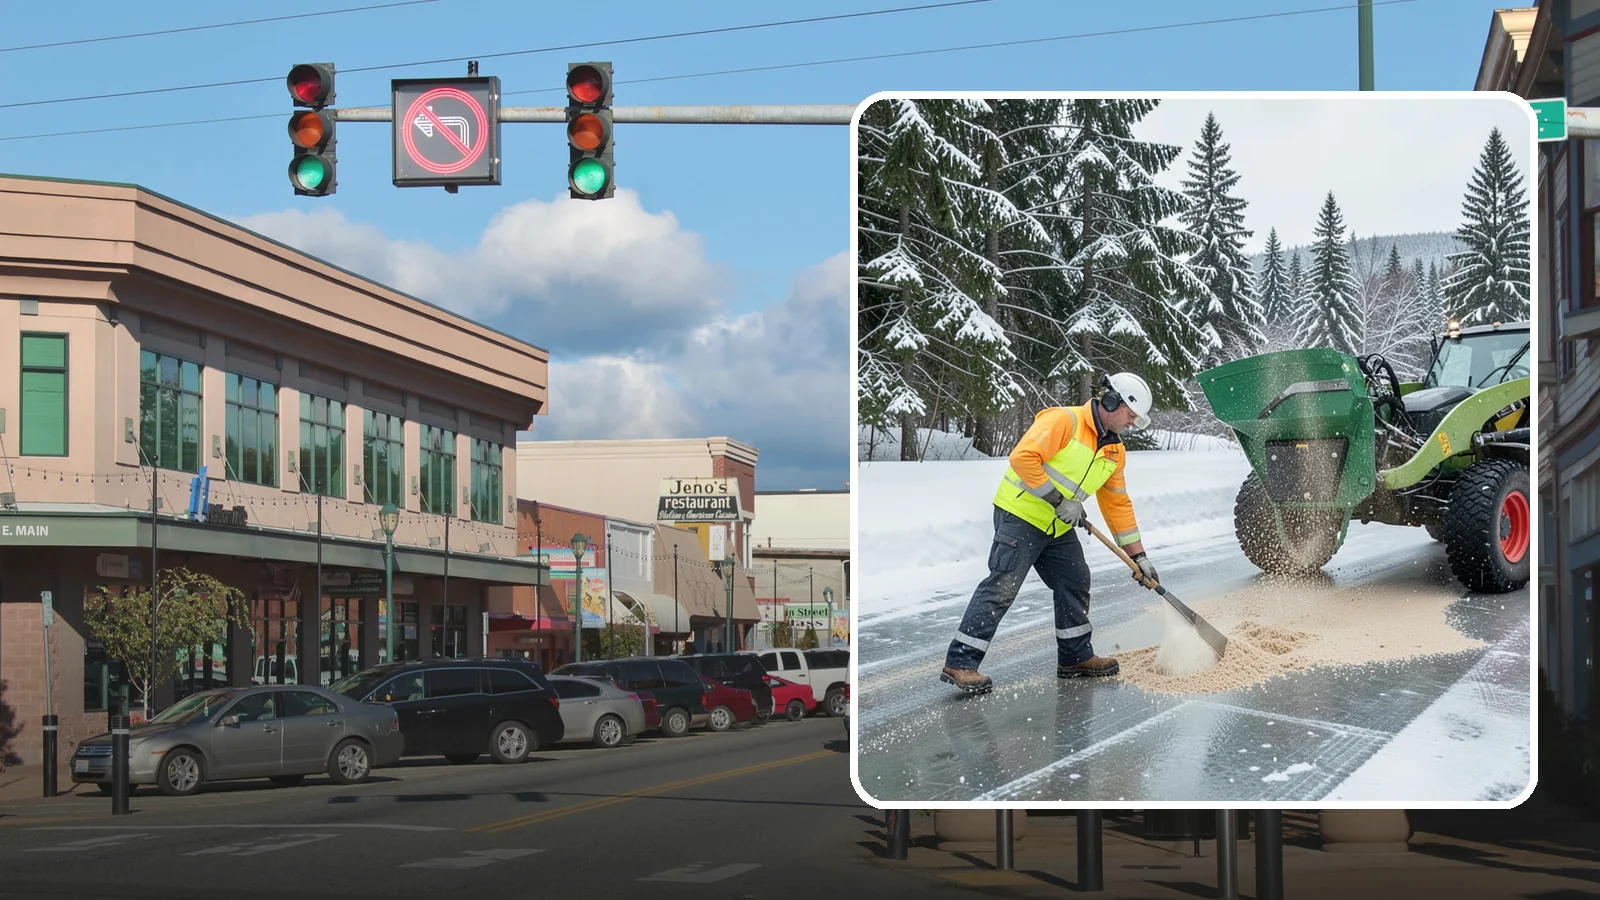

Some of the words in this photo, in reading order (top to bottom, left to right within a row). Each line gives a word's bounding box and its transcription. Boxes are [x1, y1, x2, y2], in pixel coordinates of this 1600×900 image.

[670, 480, 727, 494] Jeno's
[665, 496, 731, 509] restaurant
[686, 510, 714, 519] American
[715, 510, 738, 519] Cuisine
[2, 525, 13, 536] E.
[15, 525, 49, 536] MAIN
[797, 607, 829, 617] Street
